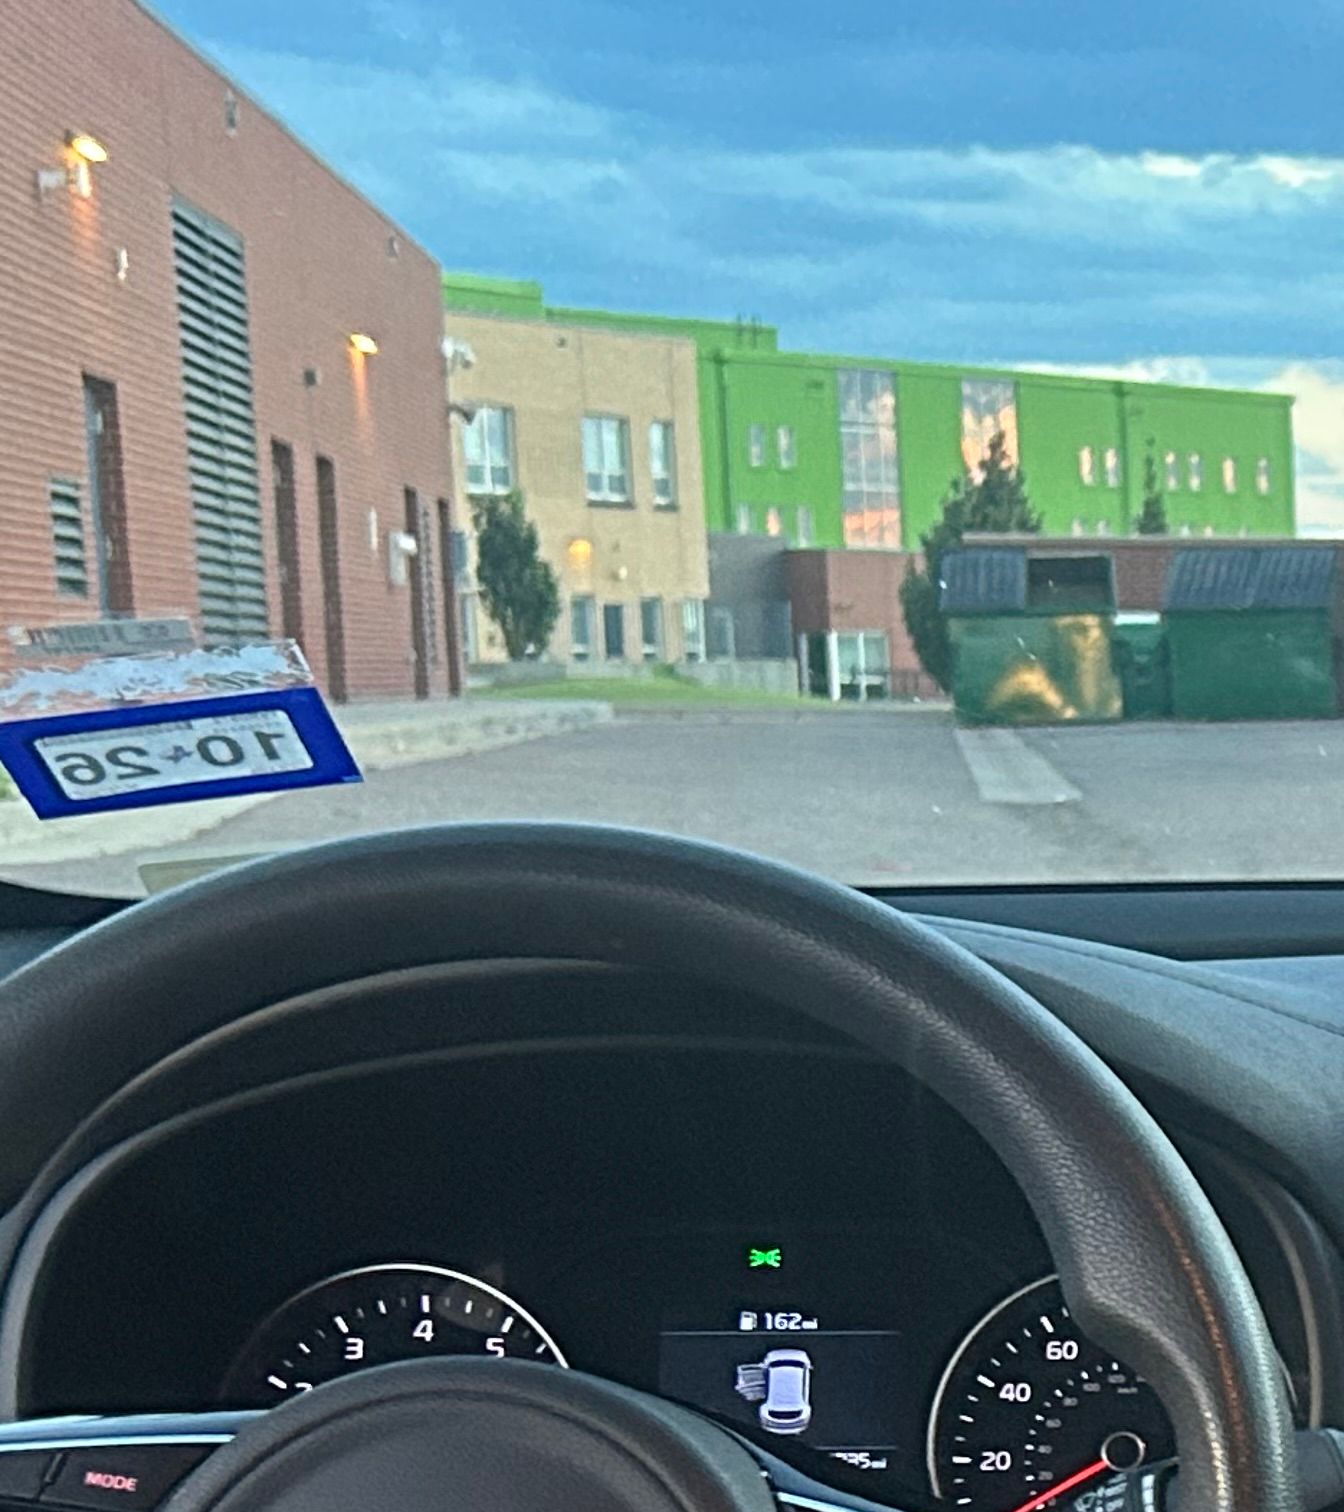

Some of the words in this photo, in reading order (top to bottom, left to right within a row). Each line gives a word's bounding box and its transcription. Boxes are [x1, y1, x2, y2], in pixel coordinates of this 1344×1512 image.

[412, 1319, 434, 1342] 4
[344, 1338, 364, 1361] 3
[485, 1336, 506, 1358] 5
[1046, 1340, 1079, 1361] 60
[999, 1382, 1031, 1402] 40
[979, 1451, 1012, 1472] 20
[84, 1471, 138, 1492] MODE
